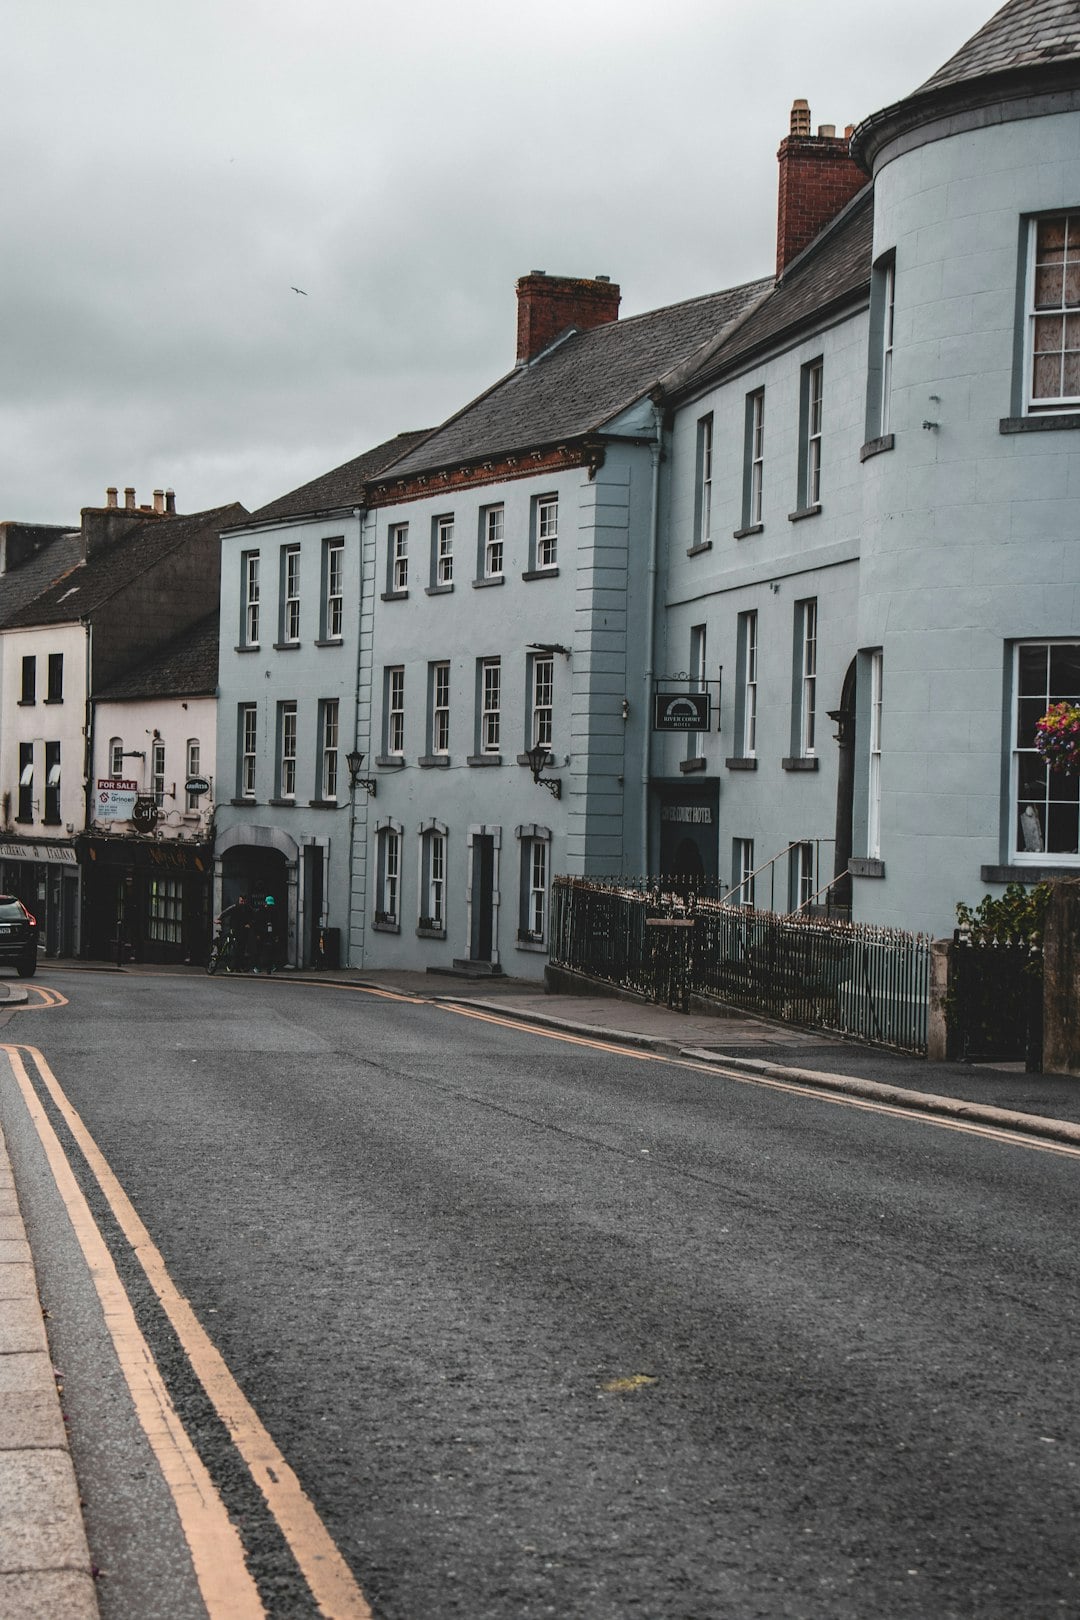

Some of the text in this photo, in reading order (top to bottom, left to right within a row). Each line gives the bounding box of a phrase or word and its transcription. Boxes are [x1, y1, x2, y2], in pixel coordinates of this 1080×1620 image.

[99, 781, 136, 790] FOR SALE
[692, 807, 712, 823] HOTEL
